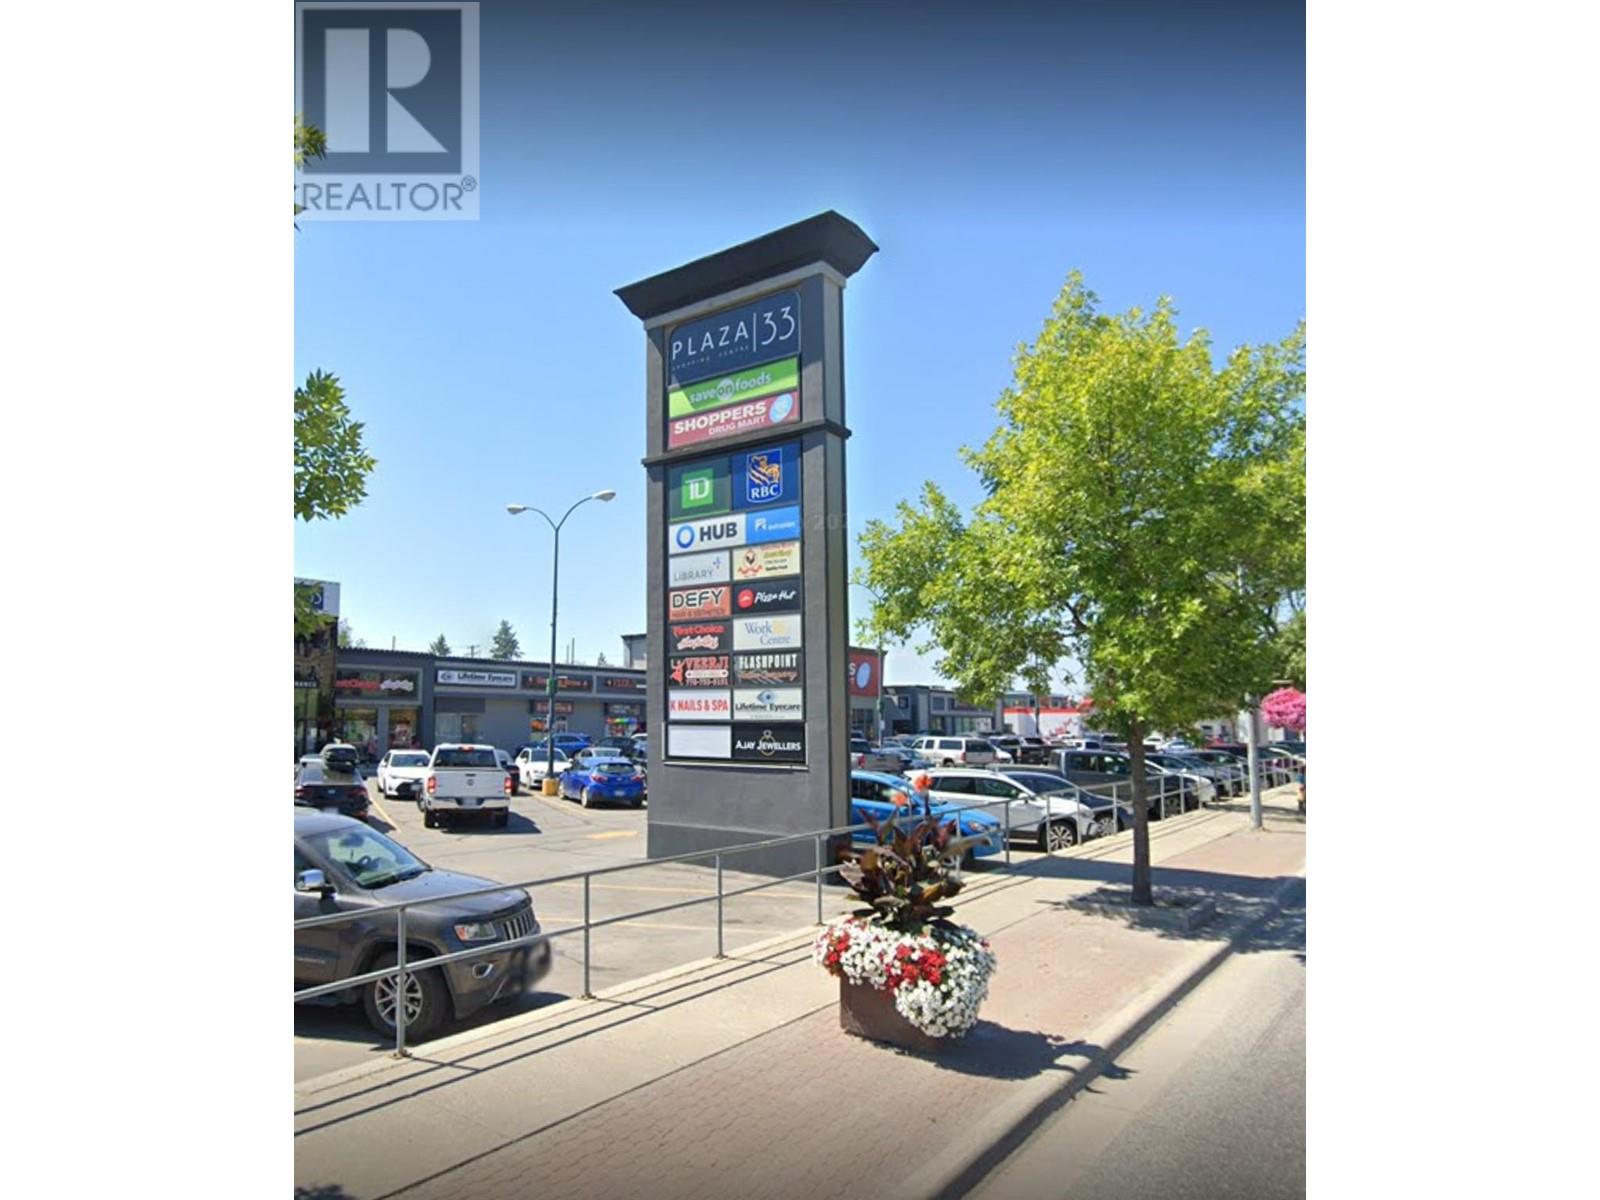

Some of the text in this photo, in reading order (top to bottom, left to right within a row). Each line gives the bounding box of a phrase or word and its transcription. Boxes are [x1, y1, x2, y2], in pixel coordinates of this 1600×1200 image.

[673, 400, 767, 435] SHOPPERS
[708, 415, 766, 436] DRUG MART
[684, 476, 710, 501] TD
[751, 484, 778, 500] RBC
[699, 522, 738, 543] HUB
[673, 568, 714, 582] LIBRARY
[672, 588, 724, 609] DEFY
[744, 620, 773, 635] Work
[760, 634, 791, 646] Centre
[677, 699, 702, 712] NAILS
[703, 699, 711, 711] &
[712, 699, 729, 711] SPA
[736, 701, 801, 713] Lifetime Eyecare
